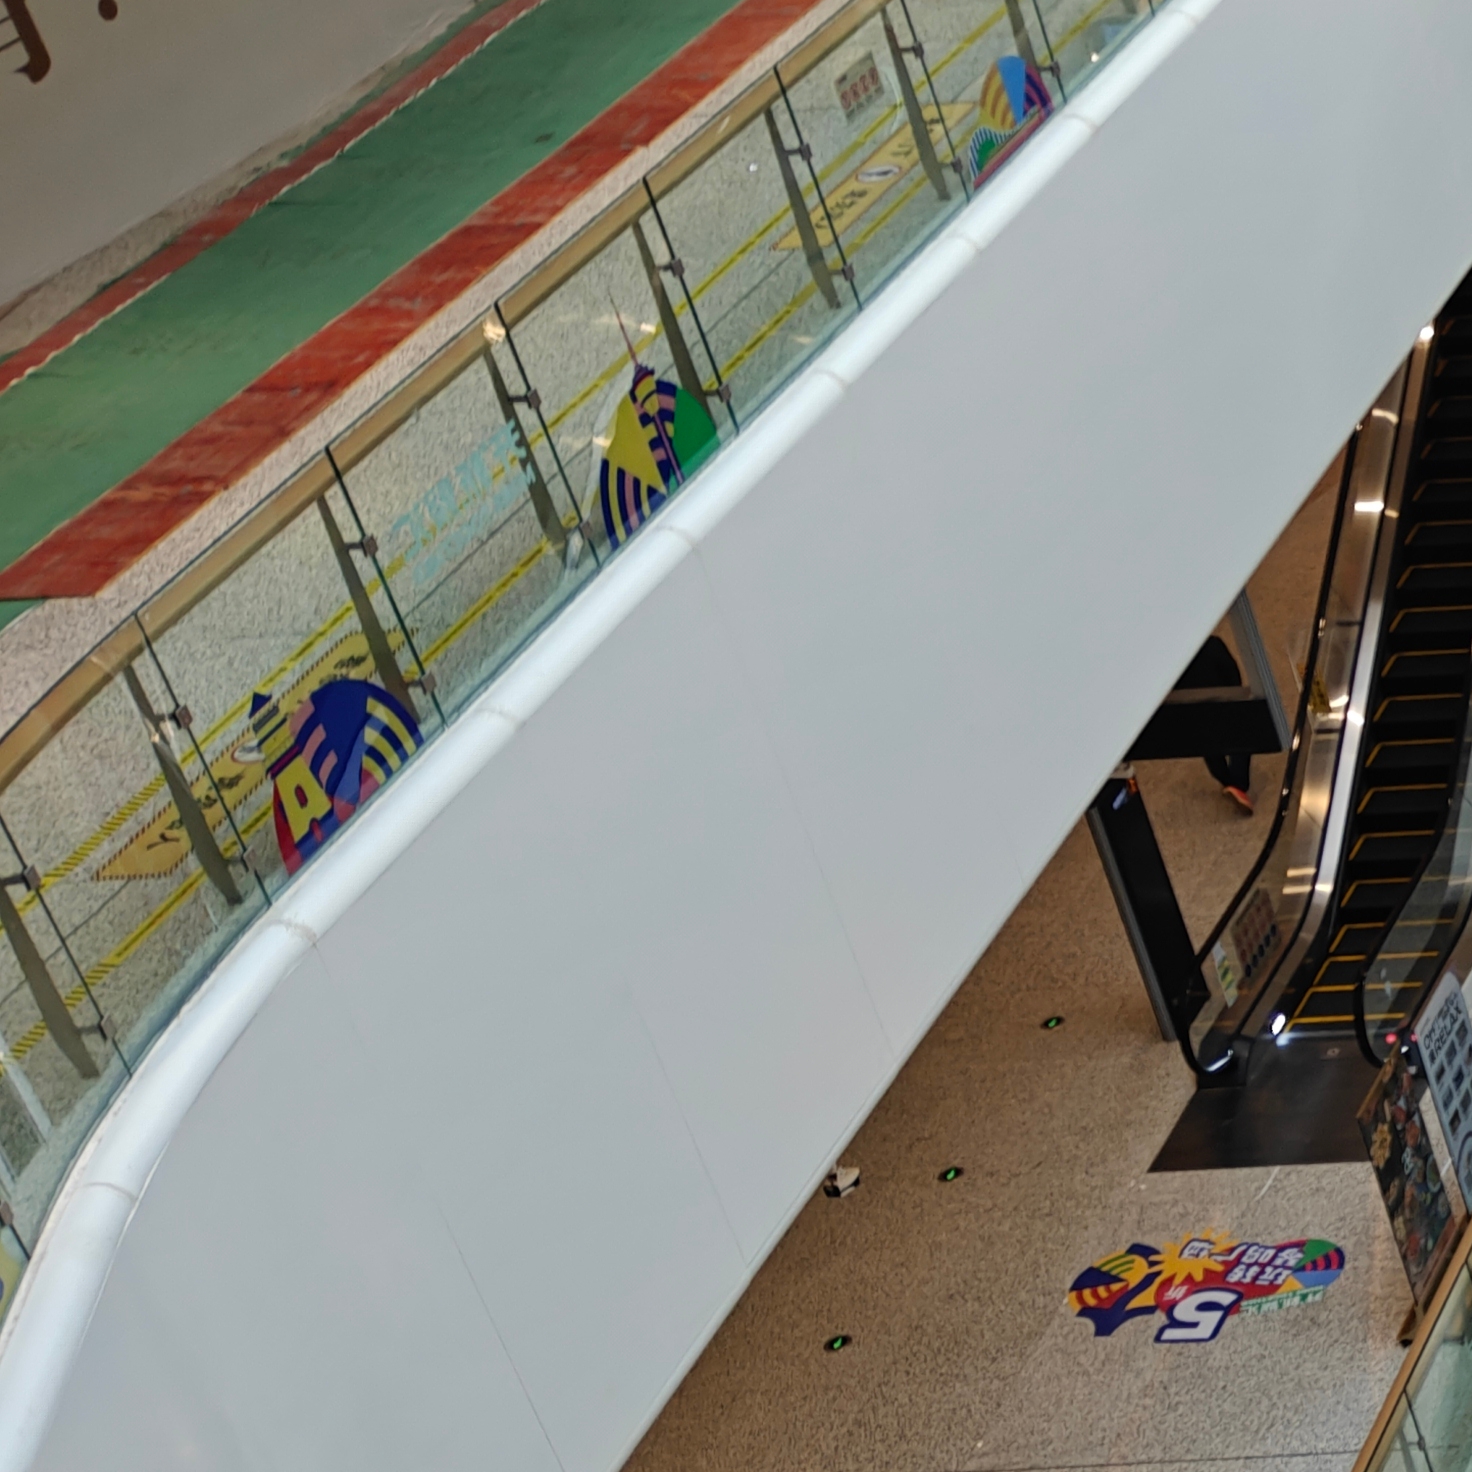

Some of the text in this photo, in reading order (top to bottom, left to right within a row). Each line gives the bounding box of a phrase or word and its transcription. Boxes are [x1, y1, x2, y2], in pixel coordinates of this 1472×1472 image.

[1180, 1240, 1305, 1266] 琴鸣广场
[1226, 1264, 1293, 1285] 玩转
[1159, 1289, 1241, 1341] 5
